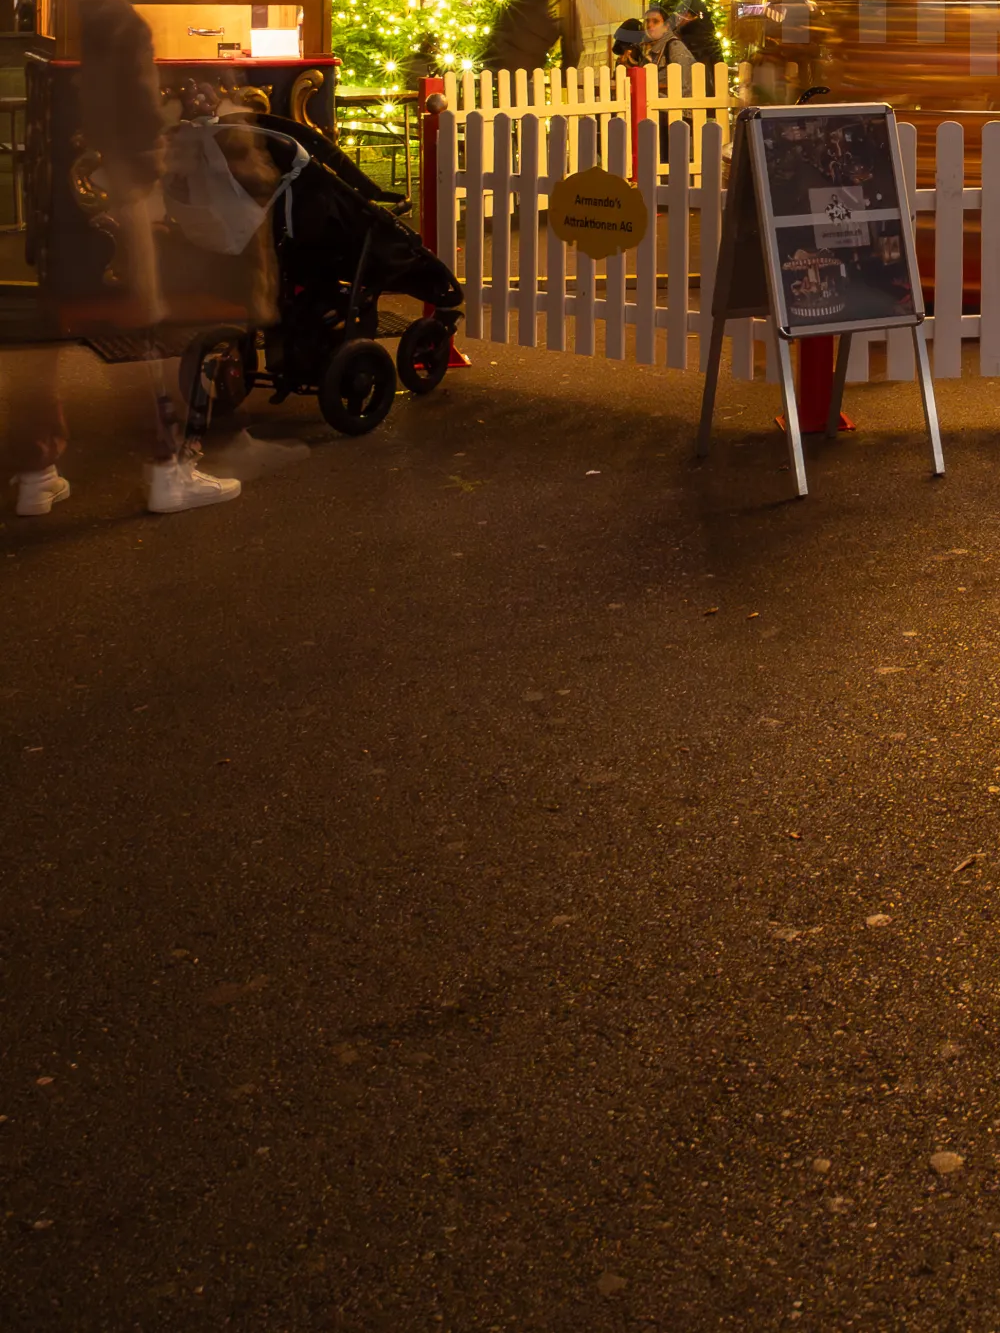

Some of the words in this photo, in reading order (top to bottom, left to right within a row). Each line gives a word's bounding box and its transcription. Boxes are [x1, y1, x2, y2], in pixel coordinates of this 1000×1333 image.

[574, 194, 622, 210] Armando's
[564, 215, 617, 231] Attraktionen
[619, 221, 633, 233] AG
